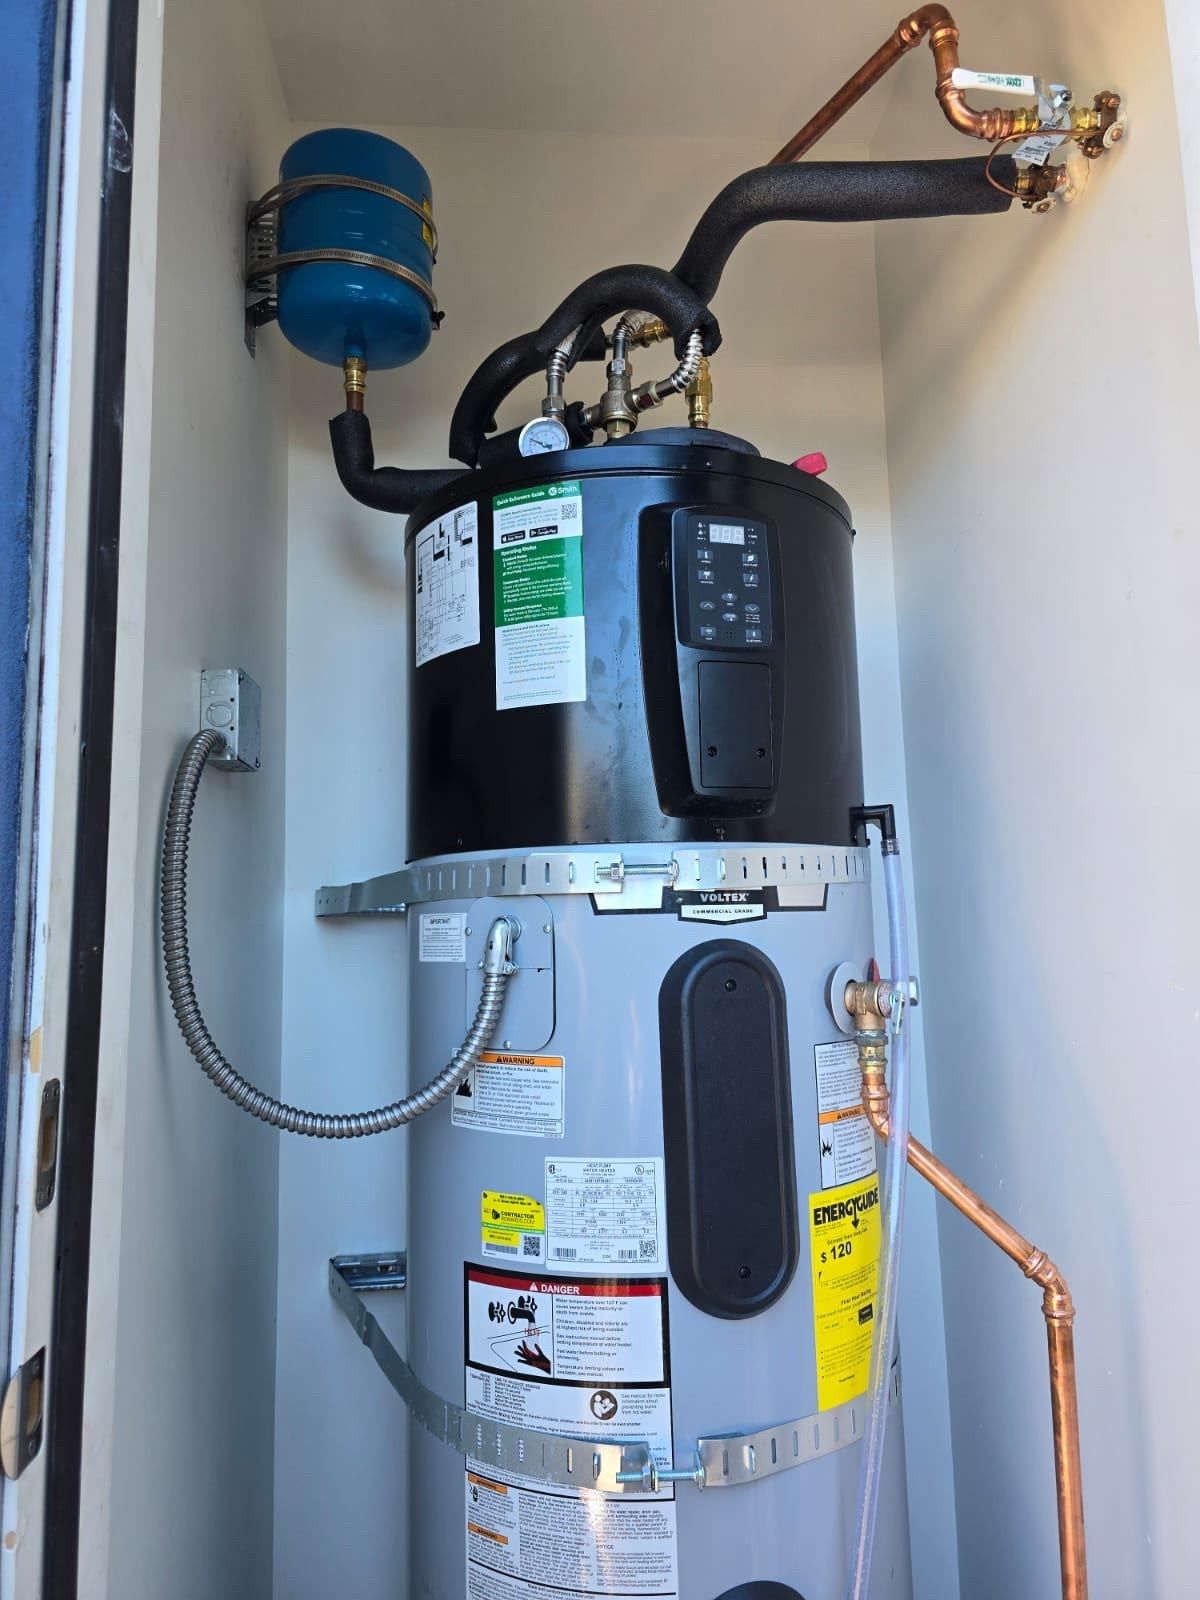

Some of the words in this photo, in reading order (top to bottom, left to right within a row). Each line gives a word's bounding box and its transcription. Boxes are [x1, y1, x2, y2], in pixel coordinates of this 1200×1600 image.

[502, 1056, 535, 1065] WARNING
[813, 1187, 878, 1226] ENERGYGUIDE
[821, 1252, 827, 1263] $
[831, 1241, 852, 1260] 120
[541, 1284, 580, 1295] DANGER
